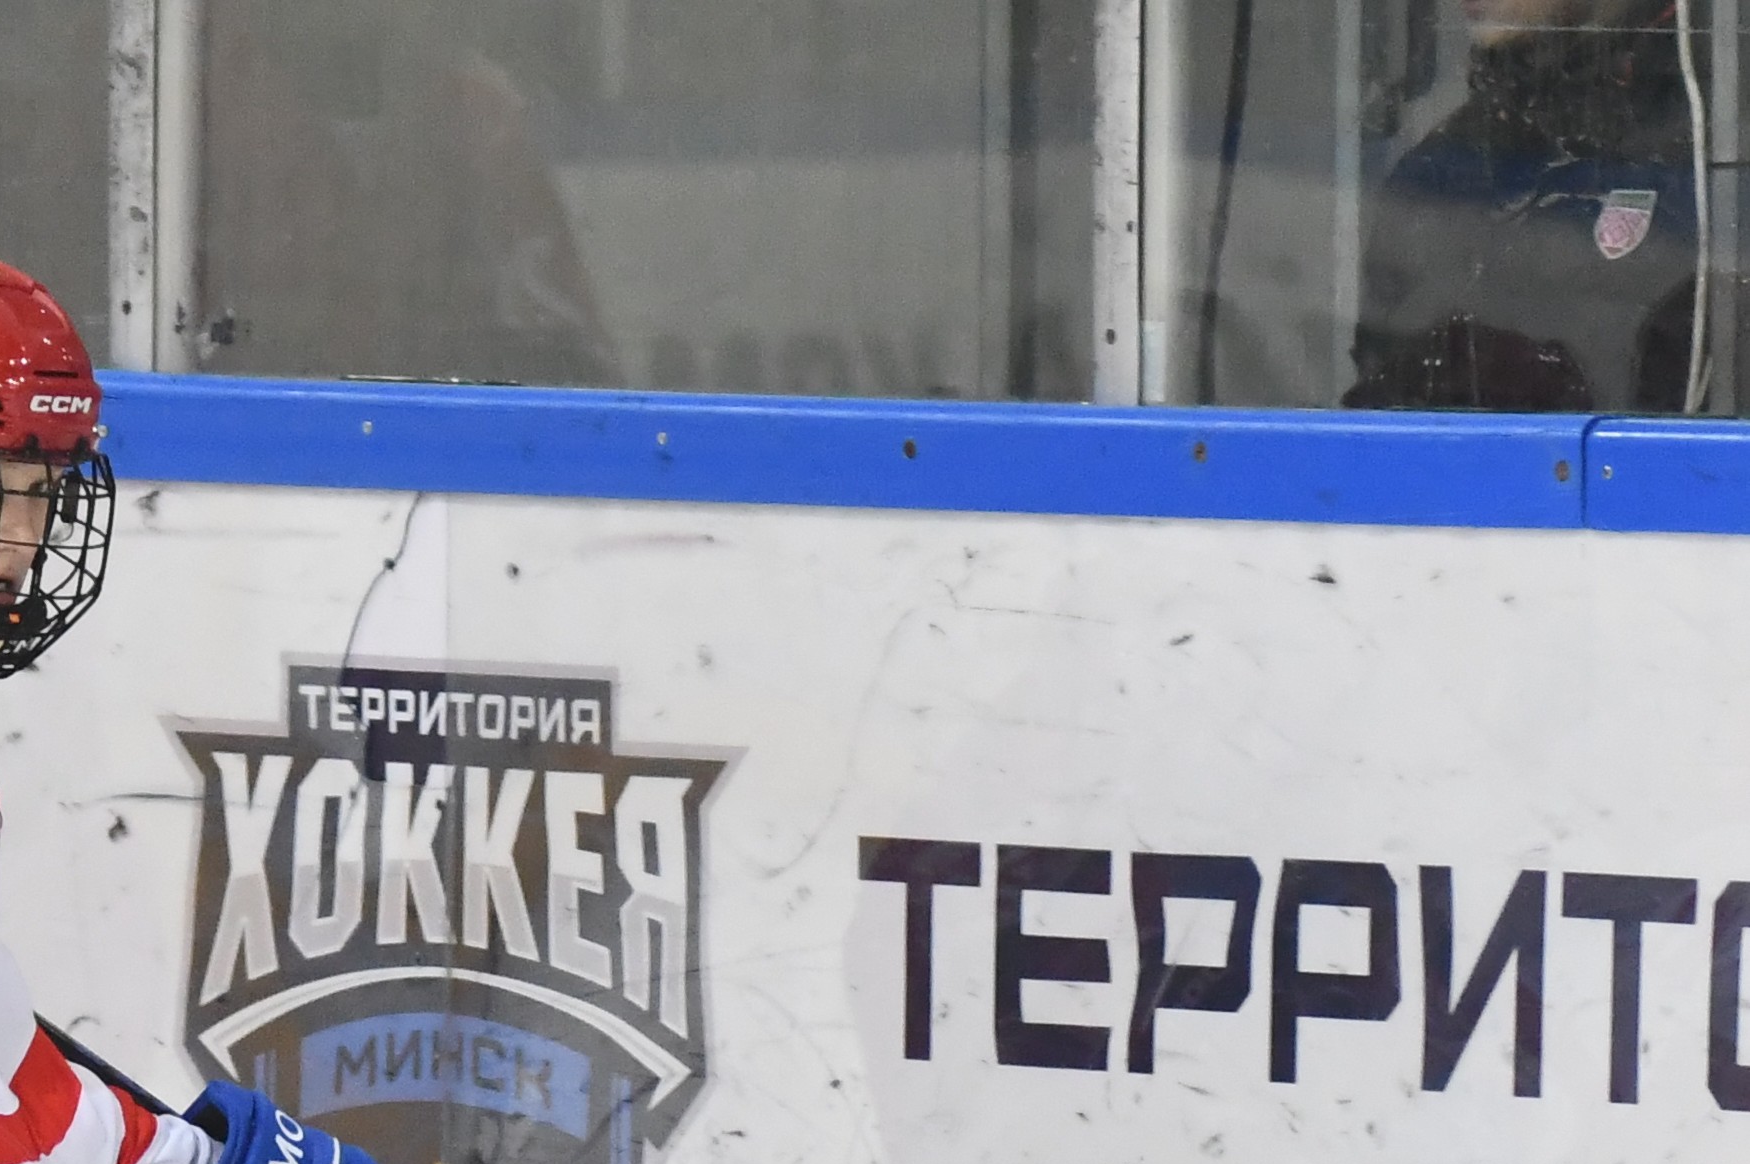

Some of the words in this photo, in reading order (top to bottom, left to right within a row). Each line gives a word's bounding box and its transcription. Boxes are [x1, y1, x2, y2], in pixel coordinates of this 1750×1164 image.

[29, 395, 93, 414] CCM
[297, 684, 601, 745] ТЕРРИТОРИЯ
[198, 751, 693, 1040] ХОККЕЯ
[333, 1029, 554, 1110] МИНСК
